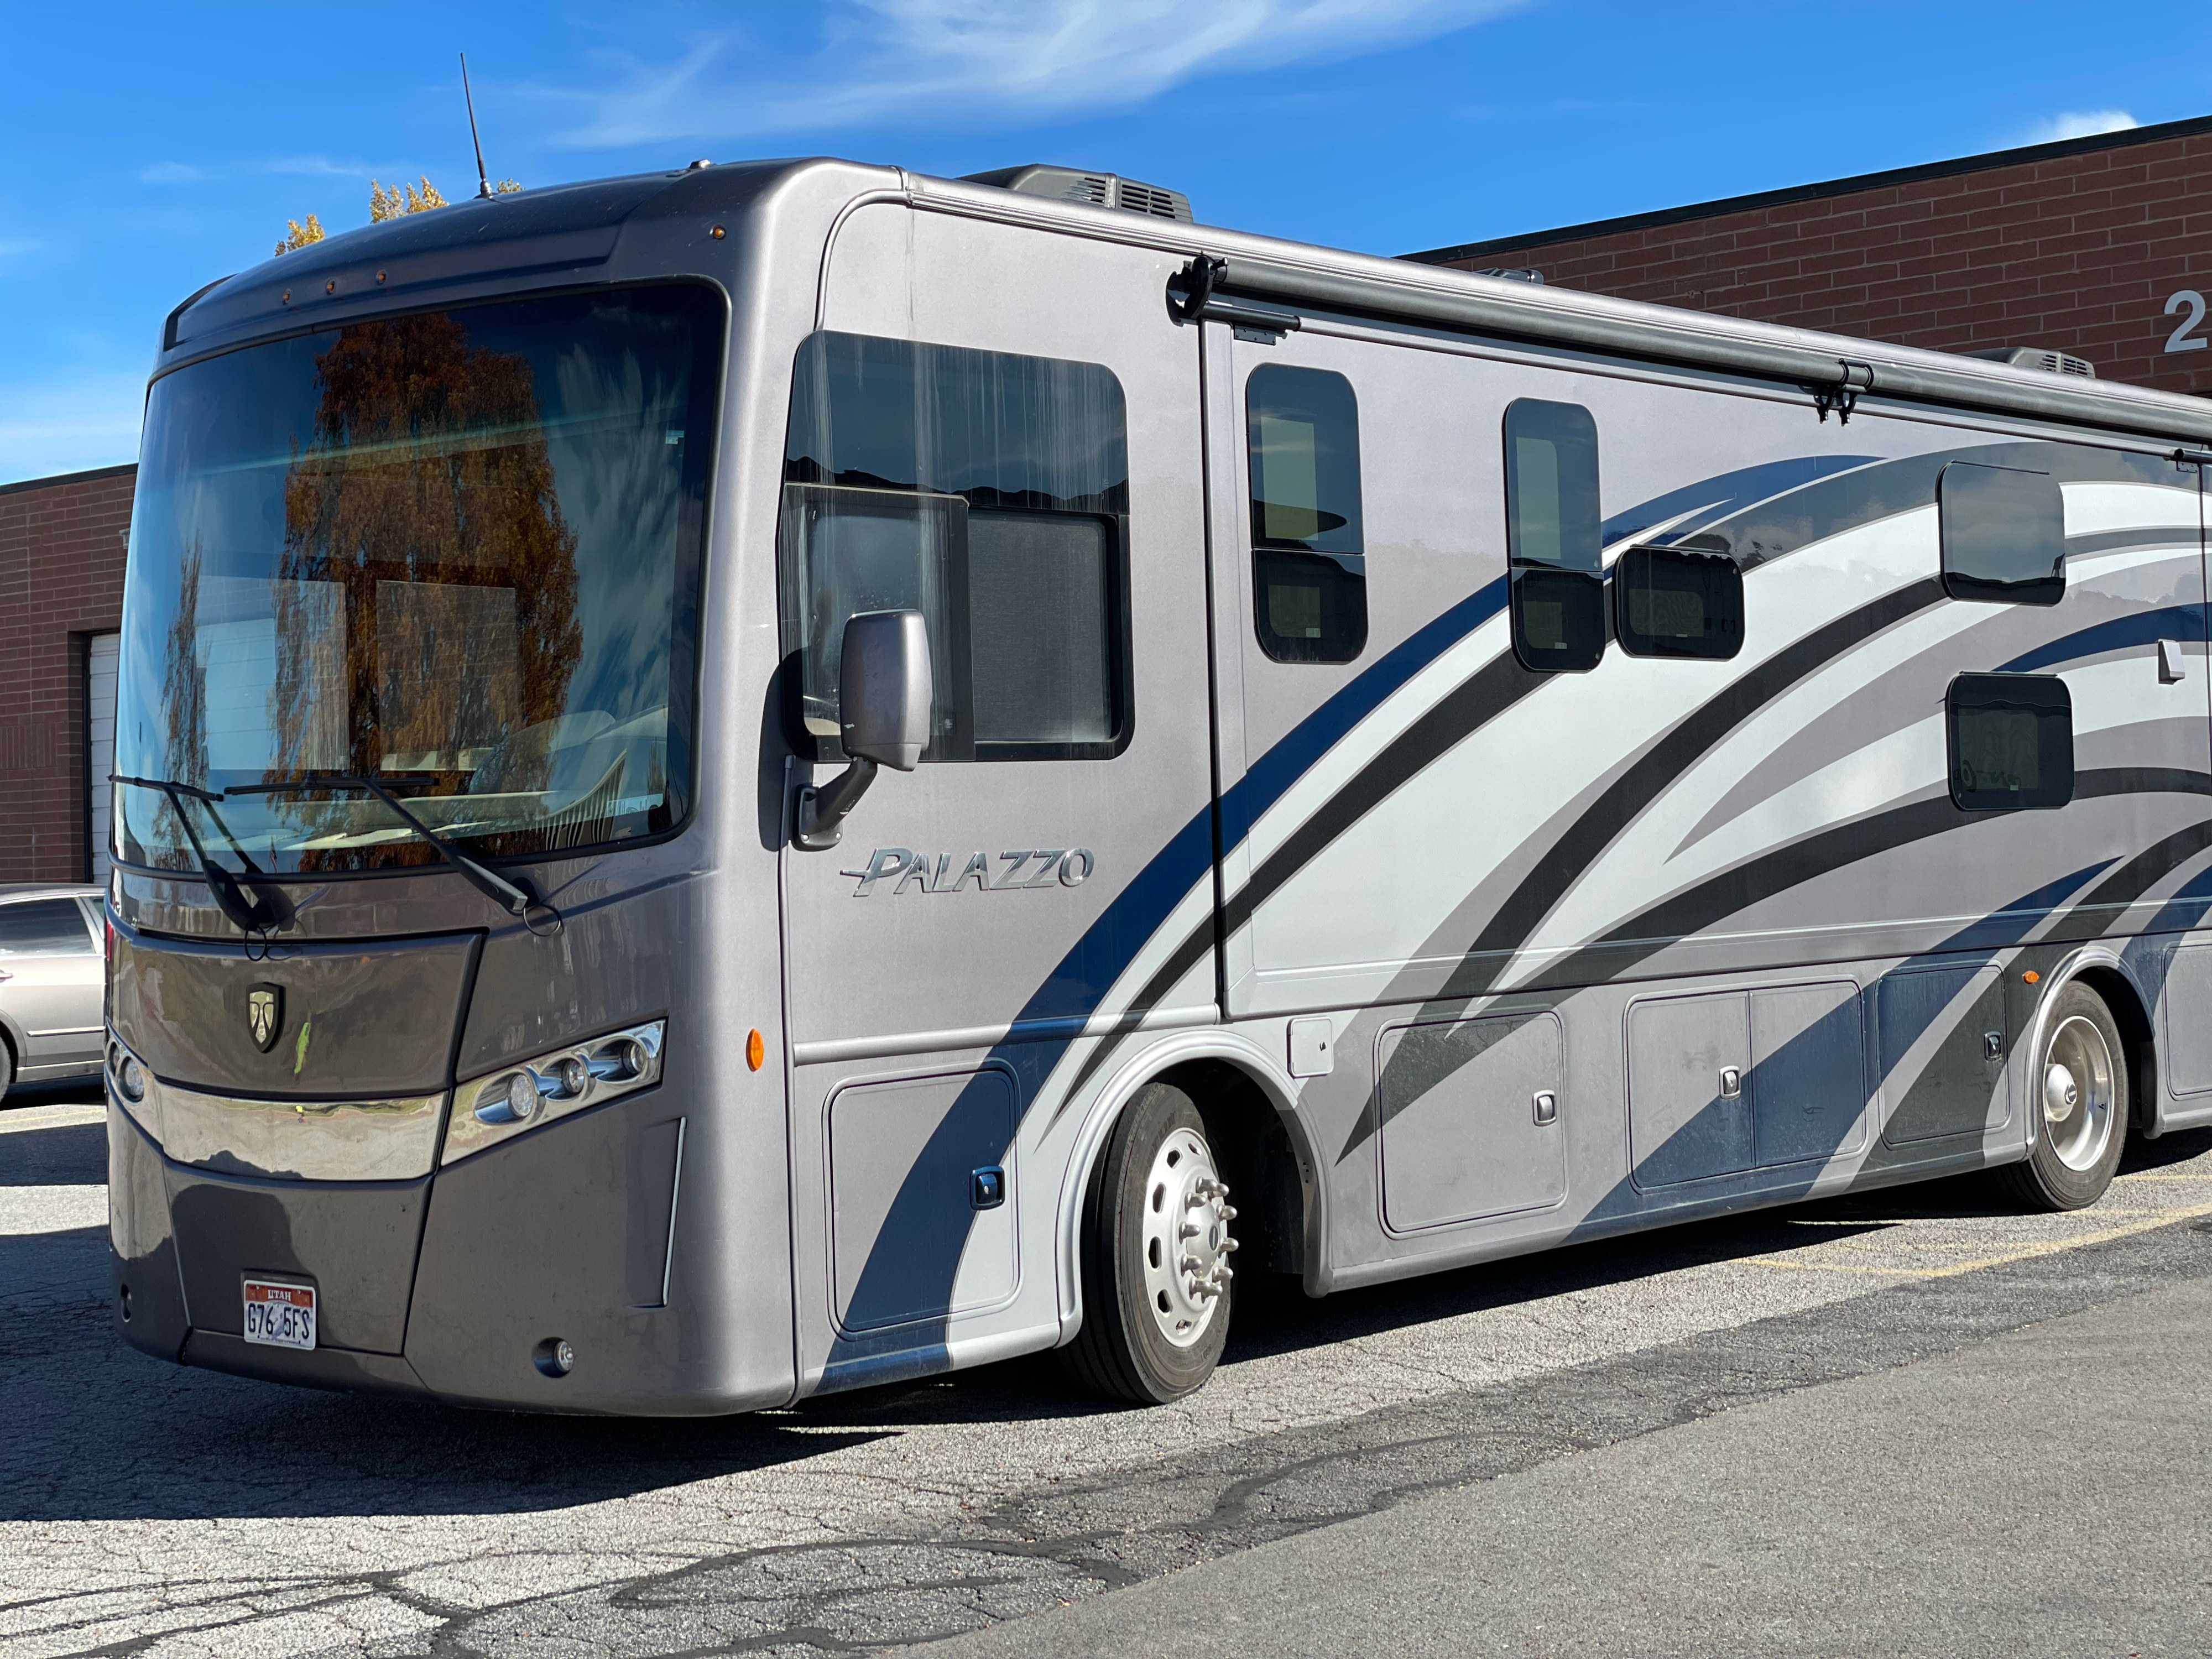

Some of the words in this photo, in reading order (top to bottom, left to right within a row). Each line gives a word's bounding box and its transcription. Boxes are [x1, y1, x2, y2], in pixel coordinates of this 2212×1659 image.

[2164, 290, 2208, 353] 2
[839, 847, 1095, 898] PALAZZO
[268, 1289, 291, 1301] UTAH
